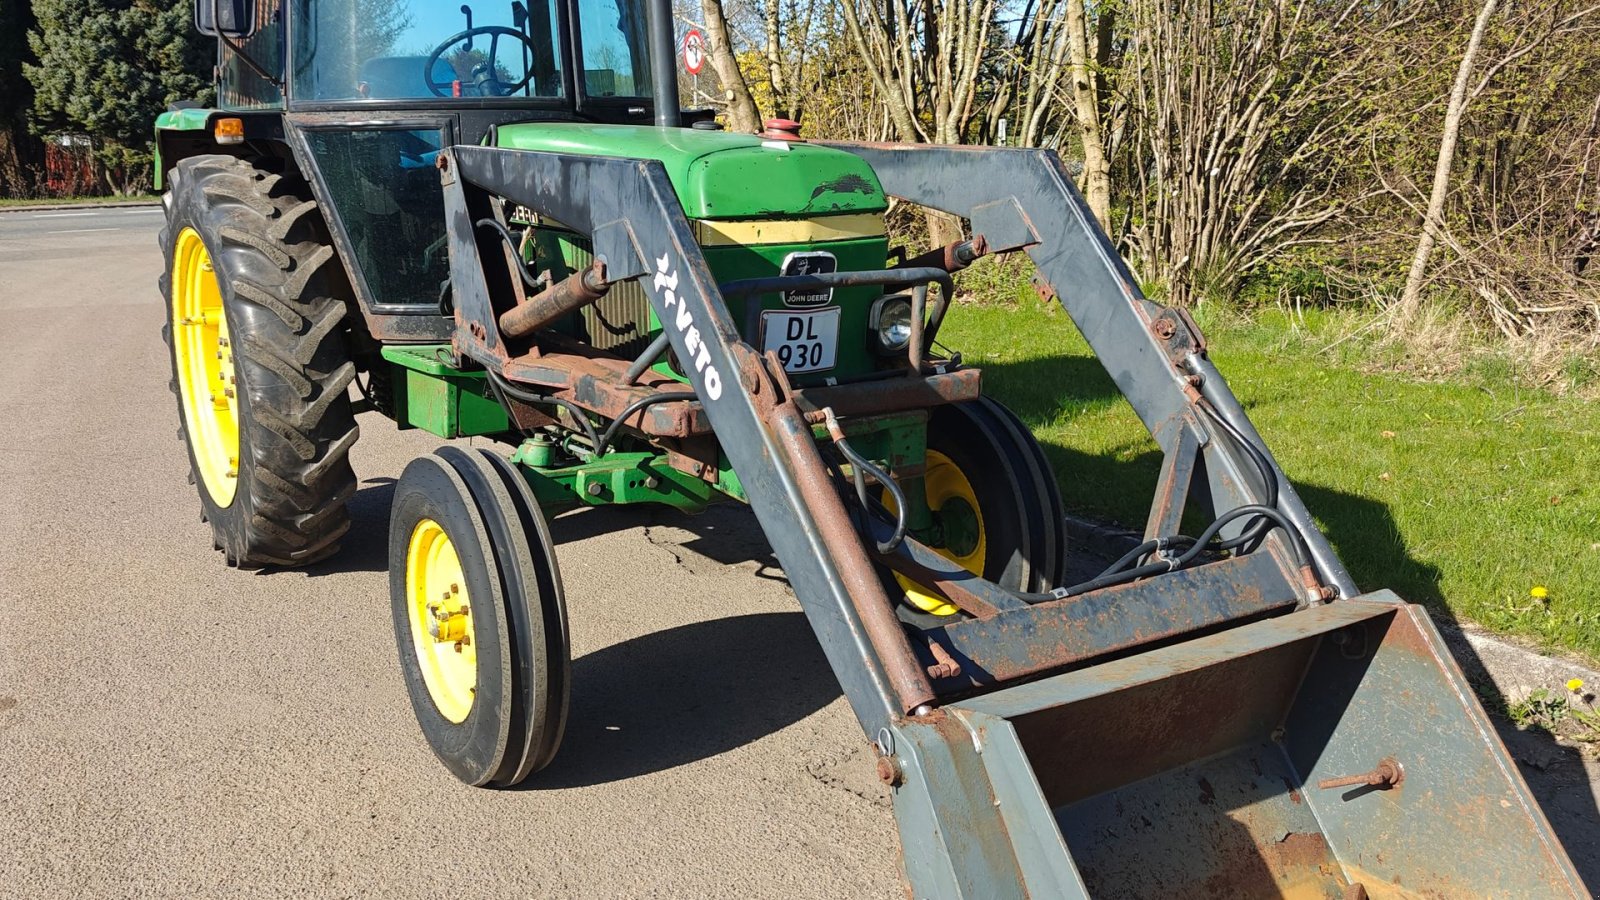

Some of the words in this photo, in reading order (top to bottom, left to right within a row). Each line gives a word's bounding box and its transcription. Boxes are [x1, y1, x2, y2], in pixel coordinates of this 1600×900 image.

[807, 294, 828, 302] DEERE
[786, 316, 818, 341] DL
[676, 296, 722, 401] VETO
[778, 343, 823, 368] 930
